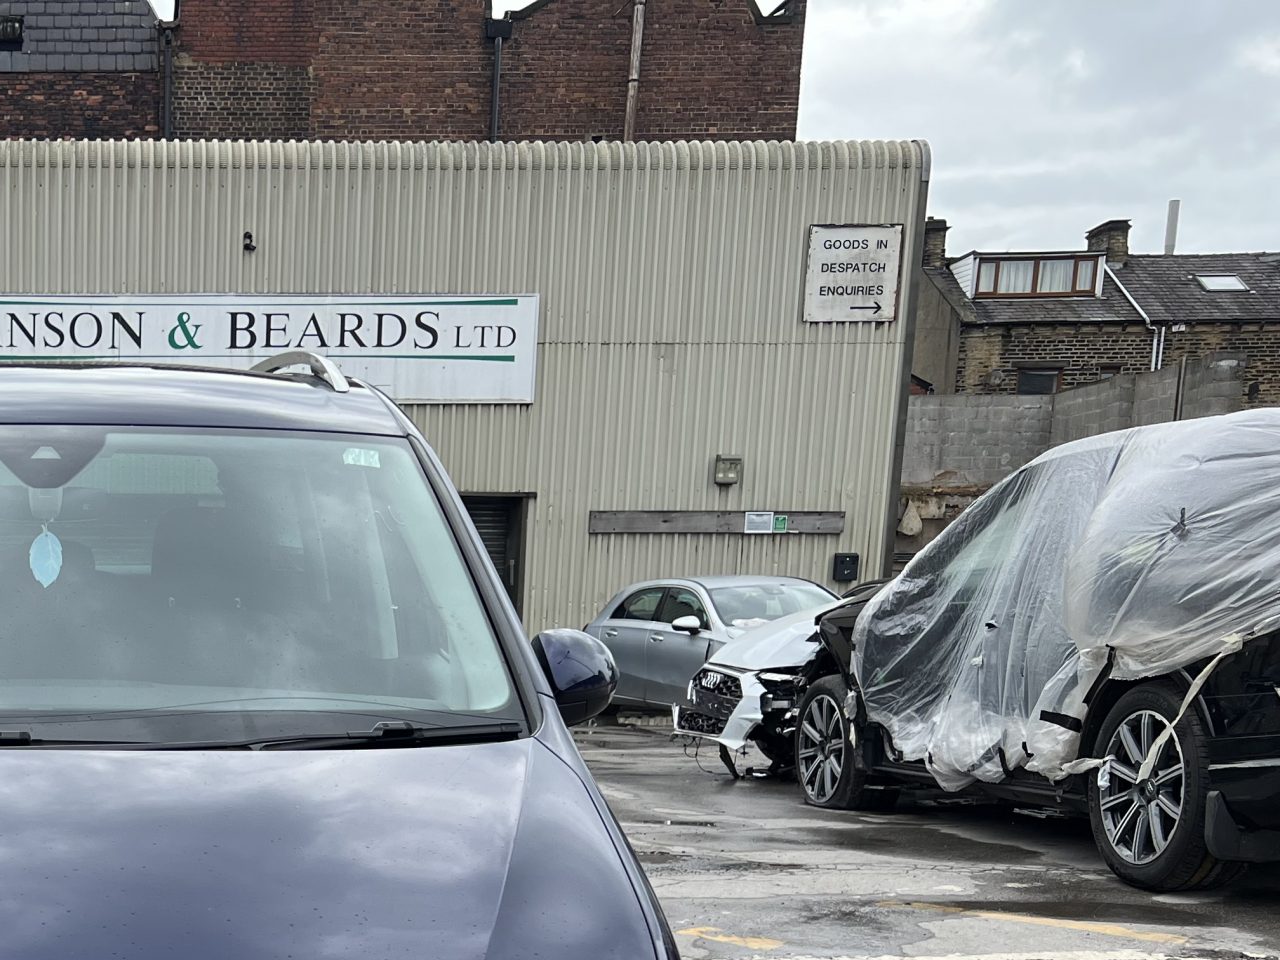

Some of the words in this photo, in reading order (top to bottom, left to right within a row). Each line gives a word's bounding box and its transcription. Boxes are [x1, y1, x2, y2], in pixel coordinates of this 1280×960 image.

[823, 239, 869, 250] GOODS
[876, 239, 888, 250] IN
[821, 262, 886, 273] DESPATCH
[819, 285, 884, 296] ENQUIRIES
[167, 310, 205, 351] &
[225, 310, 441, 351] BEARDS
[453, 325, 517, 350] LTD
